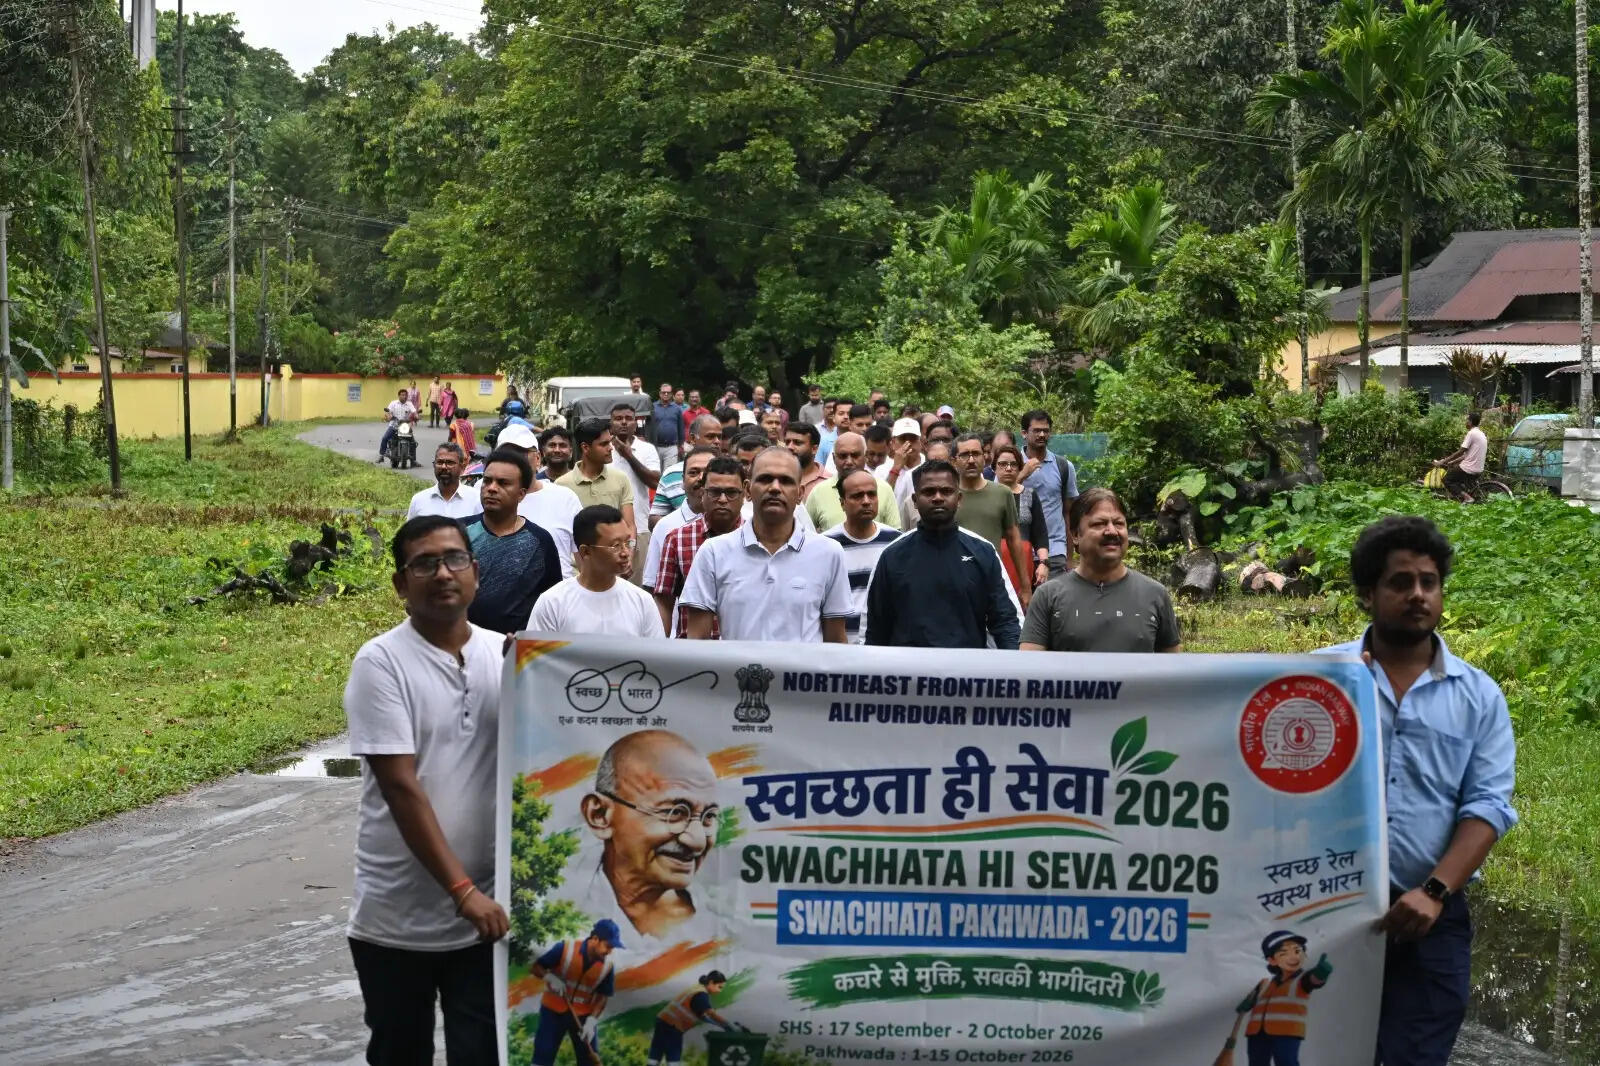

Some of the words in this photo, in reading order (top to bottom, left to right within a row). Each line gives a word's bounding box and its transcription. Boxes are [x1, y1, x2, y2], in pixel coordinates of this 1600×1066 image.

[574, 686, 603, 698] स्वच्छ
[627, 688, 654, 699] भारत
[783, 672, 912, 696] NORTHEAST
[916, 677, 1021, 699] FRONTIER
[1026, 679, 1122, 700] RAILWAY
[576, 716, 599, 726] कदम
[600, 716, 633, 727] स्वच्छता
[635, 715, 649, 726] की
[651, 715, 668, 727] ओर
[829, 702, 967, 725] ALIPURDUAR
[972, 704, 1071, 727] DIVISION
[743, 768, 931, 822] स्वच्छता
[942, 746, 996, 820] ही
[1006, 743, 1109, 816] सेवा
[1115, 779, 1229, 831] 2026
[741, 845, 966, 887] SWACHHATA
[978, 850, 1014, 888] HI
[1027, 851, 1117, 890] SEVA
[1128, 853, 1218, 894] 2026
[1264, 857, 1322, 885] स्वच्छ
[1326, 848, 1357, 870] रेल
[1257, 882, 1313, 912] स्वस्थ
[789, 899, 942, 936] SWACHHATA
[949, 903, 1088, 939] PAKHWADA
[1110, 907, 1177, 942] 2026
[833, 964, 883, 991] कचरे
[889, 962, 908, 986] से
[915, 961, 965, 992] मुक्ति,
[973, 962, 1033, 988] सबकी
[1038, 966, 1125, 998] भागीदारी
[777, 1021, 812, 1038] SHS
[830, 1022, 849, 1036] 17
[855, 1022, 951, 1040] September
[968, 1024, 977, 1038] 2
[984, 1024, 1054, 1040] October
[1060, 1026, 1104, 1042] 2026
[804, 1045, 895, 1062] Pakhwada
[911, 1049, 950, 1064] 1-15
[954, 1049, 1028, 1064] October
[1031, 1049, 1074, 1063] 2026
